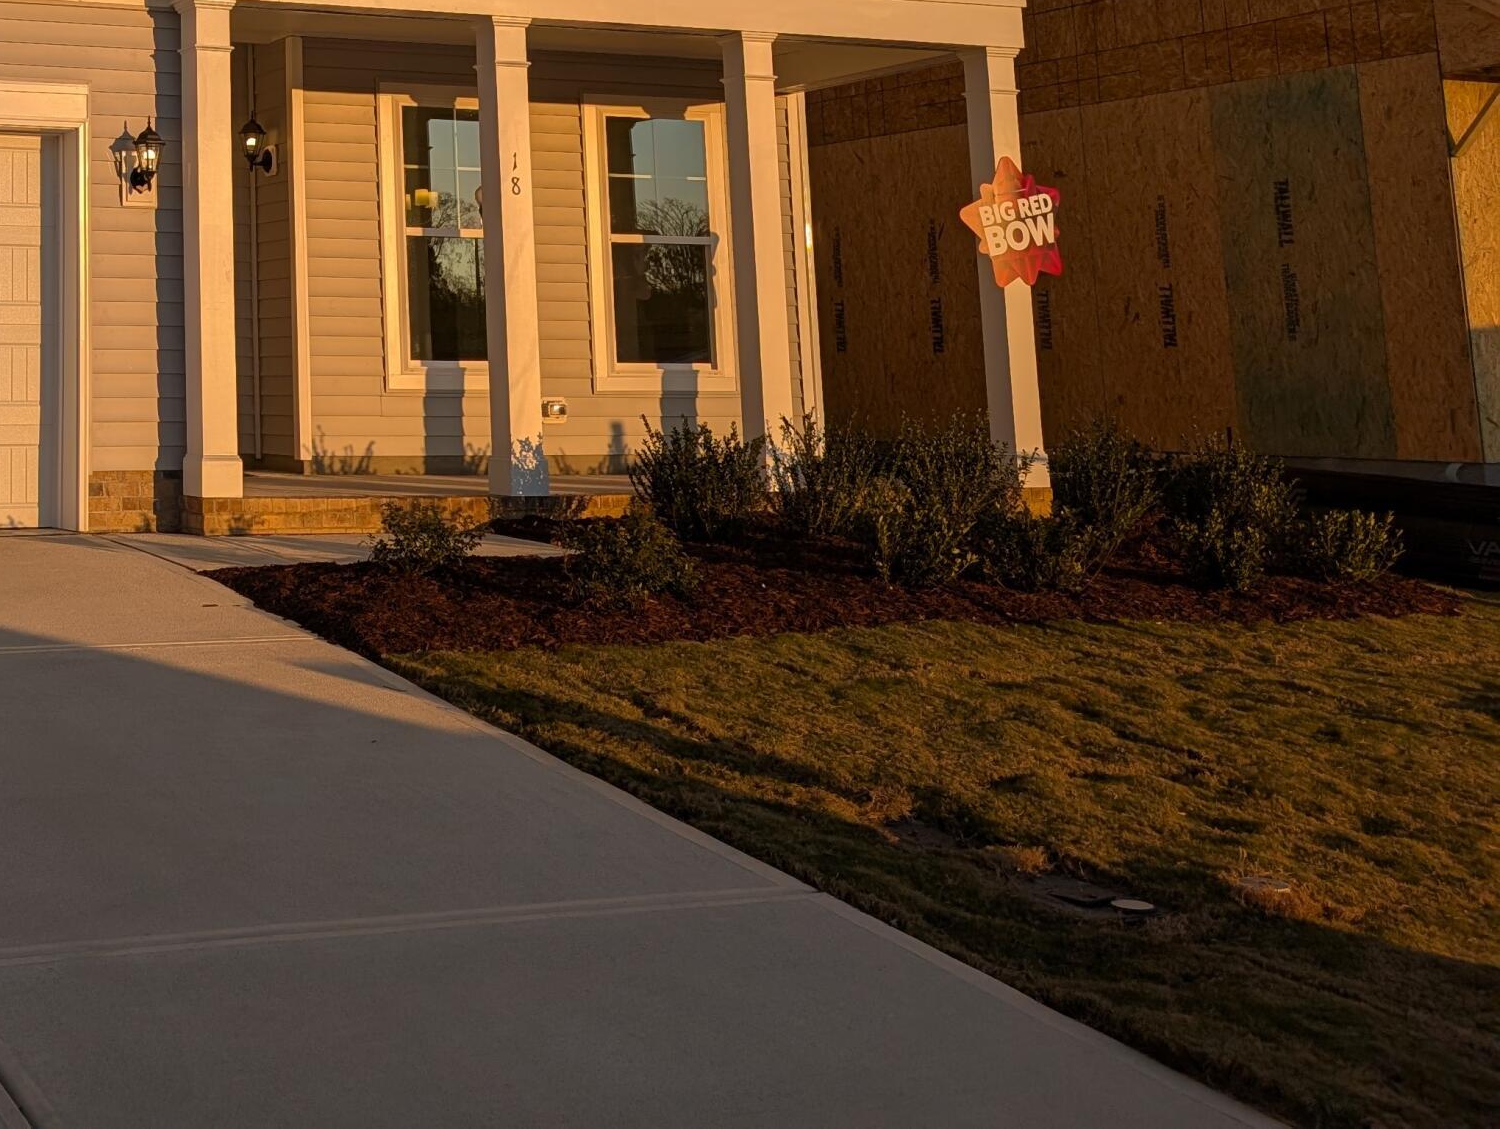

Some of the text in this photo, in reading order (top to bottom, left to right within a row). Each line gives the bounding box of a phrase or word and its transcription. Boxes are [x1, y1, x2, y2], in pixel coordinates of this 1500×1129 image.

[511, 151, 521, 196] 18
[978, 193, 1053, 227] BIG RED
[1273, 177, 1294, 248] TALLWALL
[984, 212, 1055, 257] BOW
[1159, 283, 1178, 349] TALLWALL
